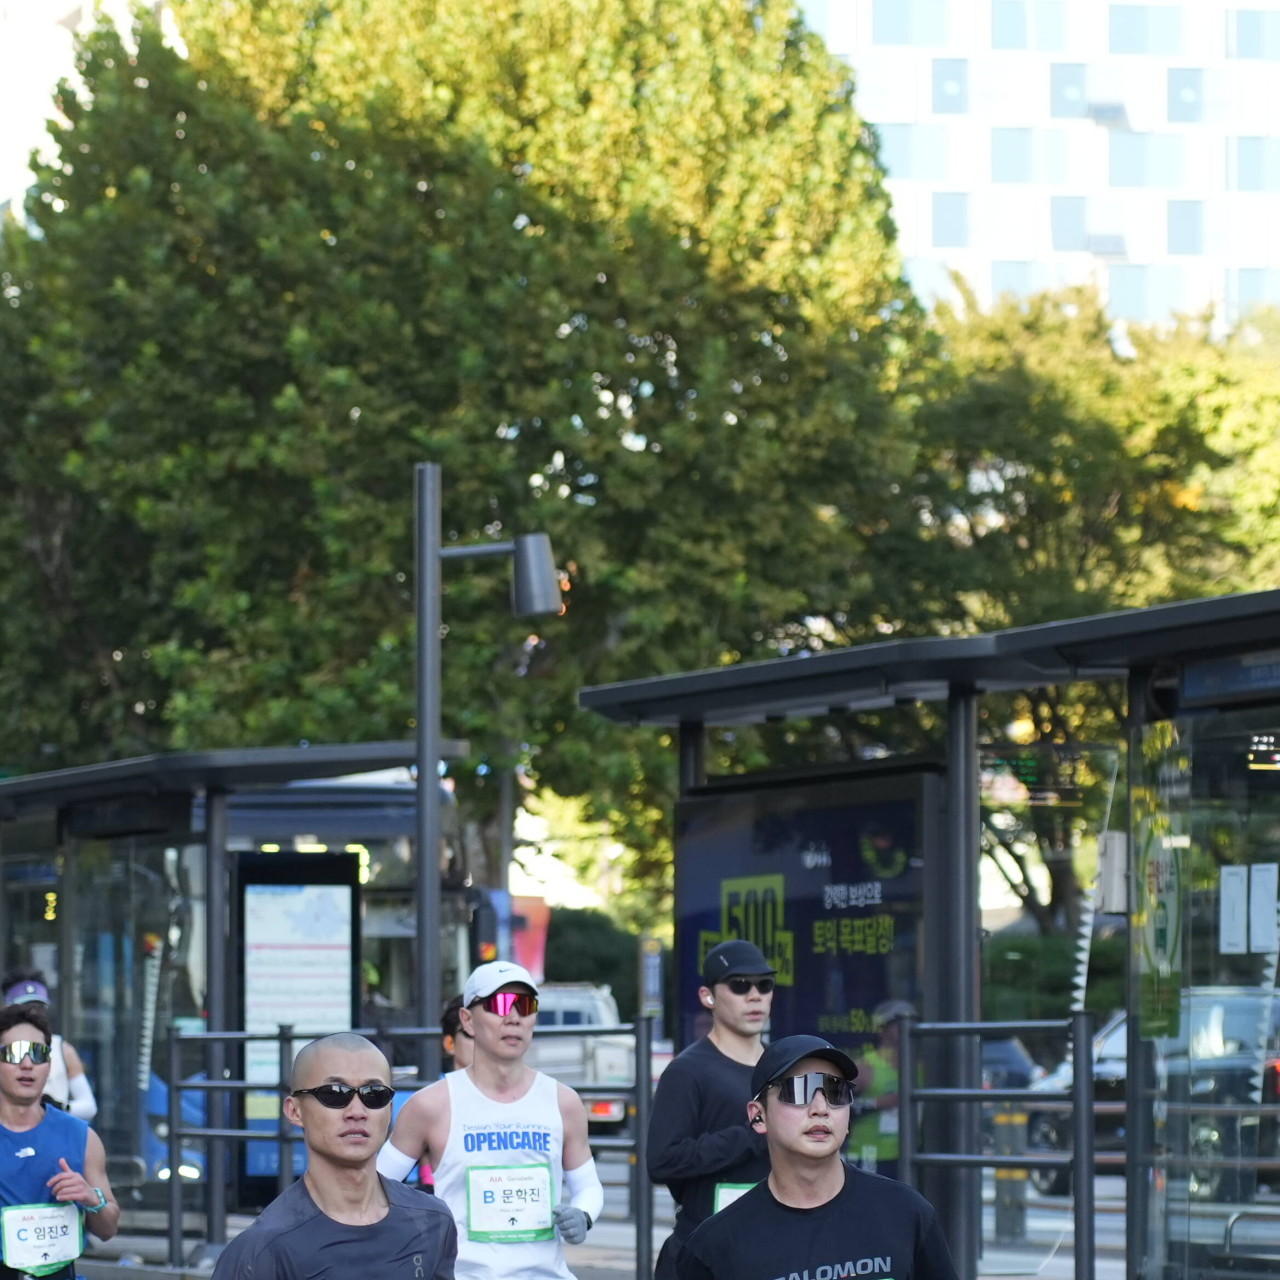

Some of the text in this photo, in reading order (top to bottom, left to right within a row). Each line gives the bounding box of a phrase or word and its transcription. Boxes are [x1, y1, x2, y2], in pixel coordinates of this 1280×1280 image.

[463, 1131, 551, 1152] OPENCARE
[483, 1187, 540, 1204] B 문학진
[17, 1225, 70, 1242] C 임진호
